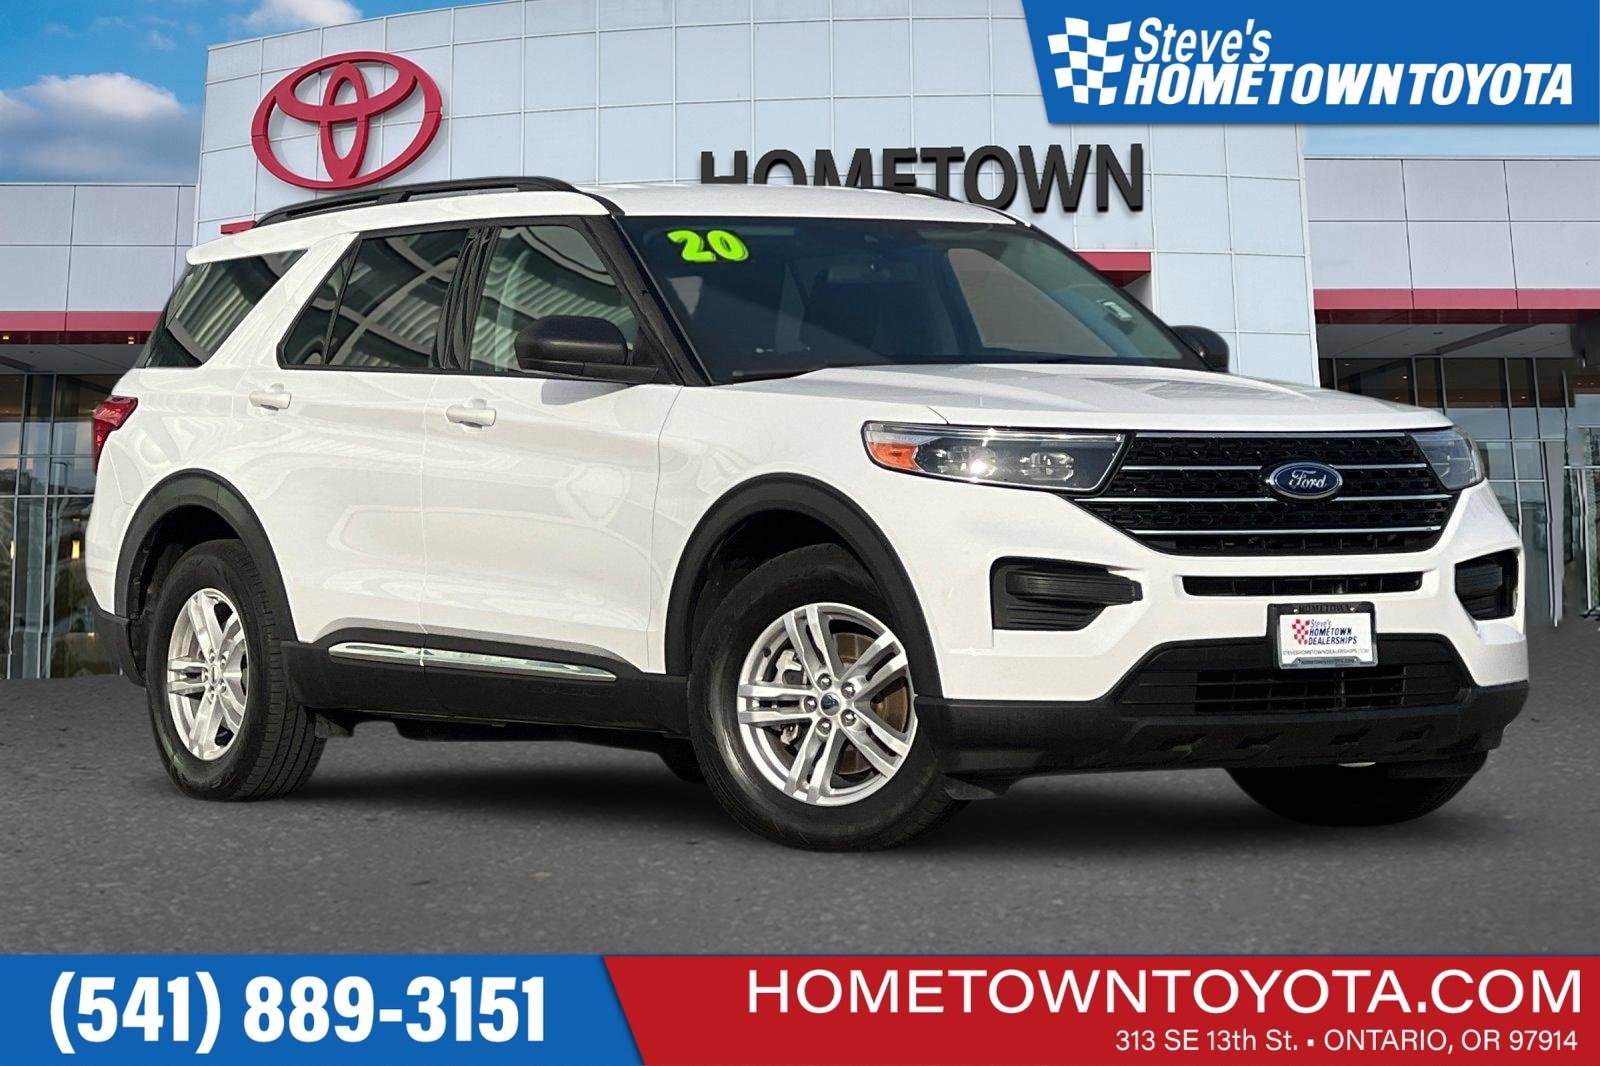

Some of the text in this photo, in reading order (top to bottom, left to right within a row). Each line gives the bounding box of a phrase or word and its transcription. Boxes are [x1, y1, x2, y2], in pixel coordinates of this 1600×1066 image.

[666, 229, 749, 263] 20
[1288, 469, 1328, 489] Ford
[1310, 619, 1332, 628] Steve's
[1309, 627, 1352, 636] HOMETOWN
[1308, 636, 1358, 645] DEALERSHIPS
